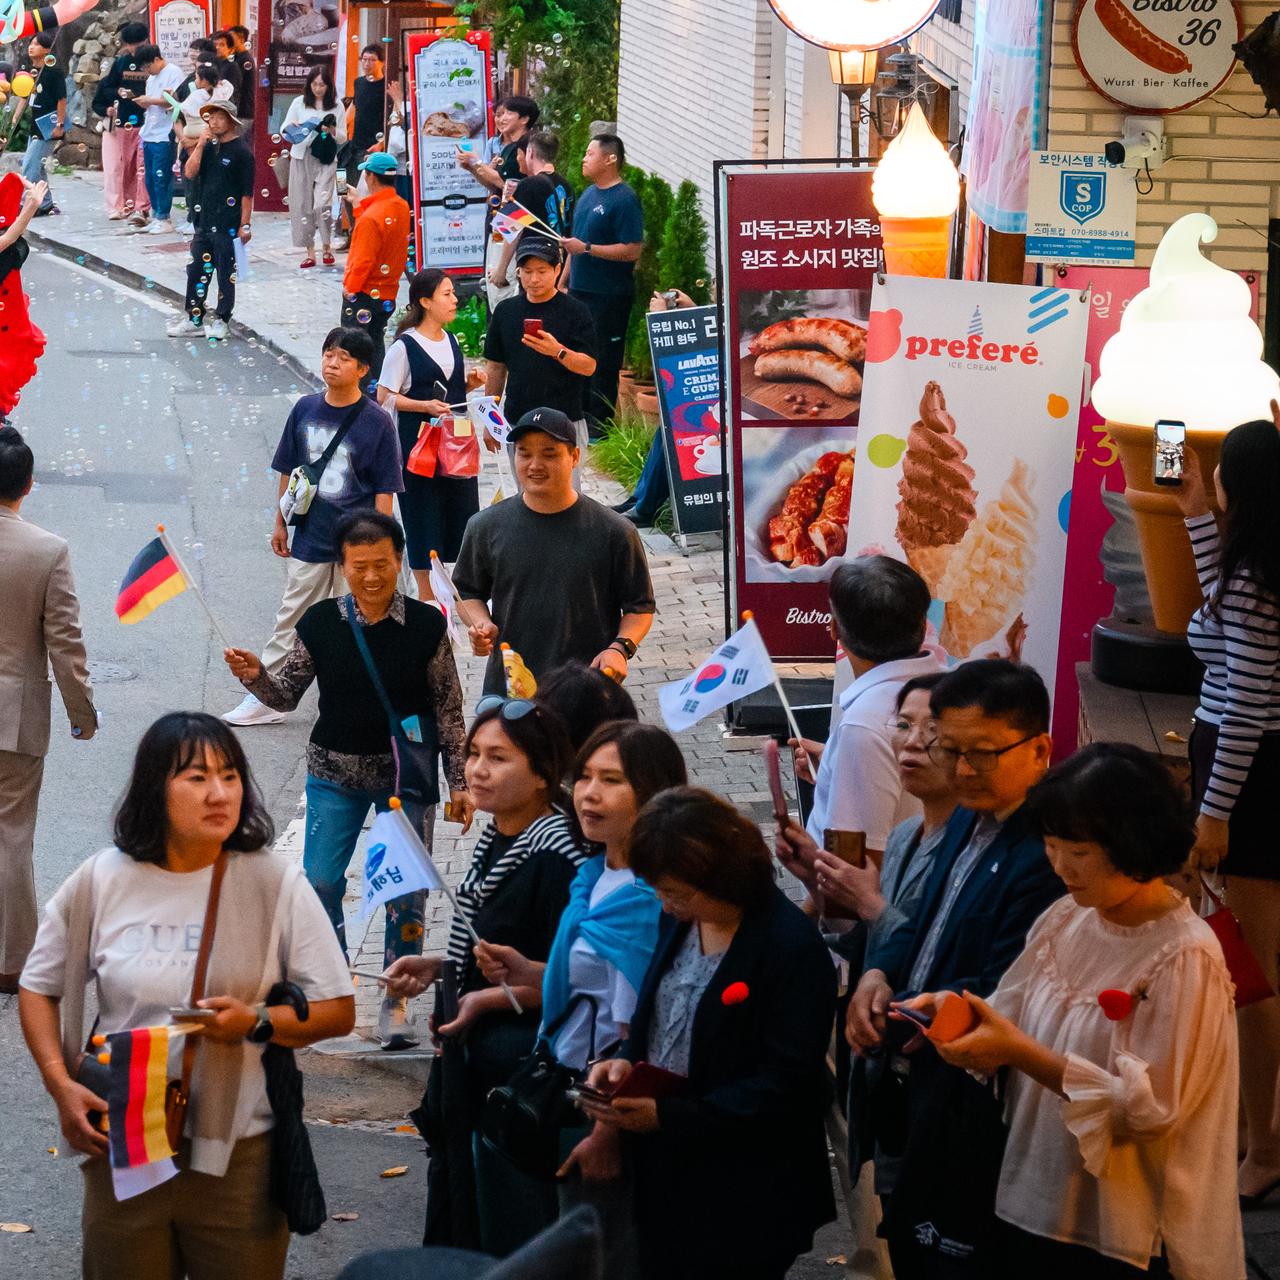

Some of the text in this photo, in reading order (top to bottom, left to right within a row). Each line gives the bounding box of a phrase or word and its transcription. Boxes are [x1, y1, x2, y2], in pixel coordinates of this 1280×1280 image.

[1178, 18, 1222, 47] 36
[1104, 77, 1209, 88] Wurst Bier Kaffee
[1040, 153, 1094, 168] 보안시스템
[1075, 182, 1092, 203] S
[1071, 204, 1093, 213] COP
[739, 218, 832, 240] 파독근로자
[741, 248, 884, 270] 원조 소시지 맛집!
[651, 320, 672, 334] 유럽
[674, 318, 697, 331] No.1
[653, 333, 698, 348] 커피 원두
[905, 335, 1039, 365] preferé
[948, 361, 997, 373] ICE CREAM
[684, 373, 718, 385] CREM
[691, 383, 719, 395] GUST
[684, 493, 714, 506] 유럽의
[786, 607, 832, 625] Bistro
[120, 923, 202, 953] GUE
